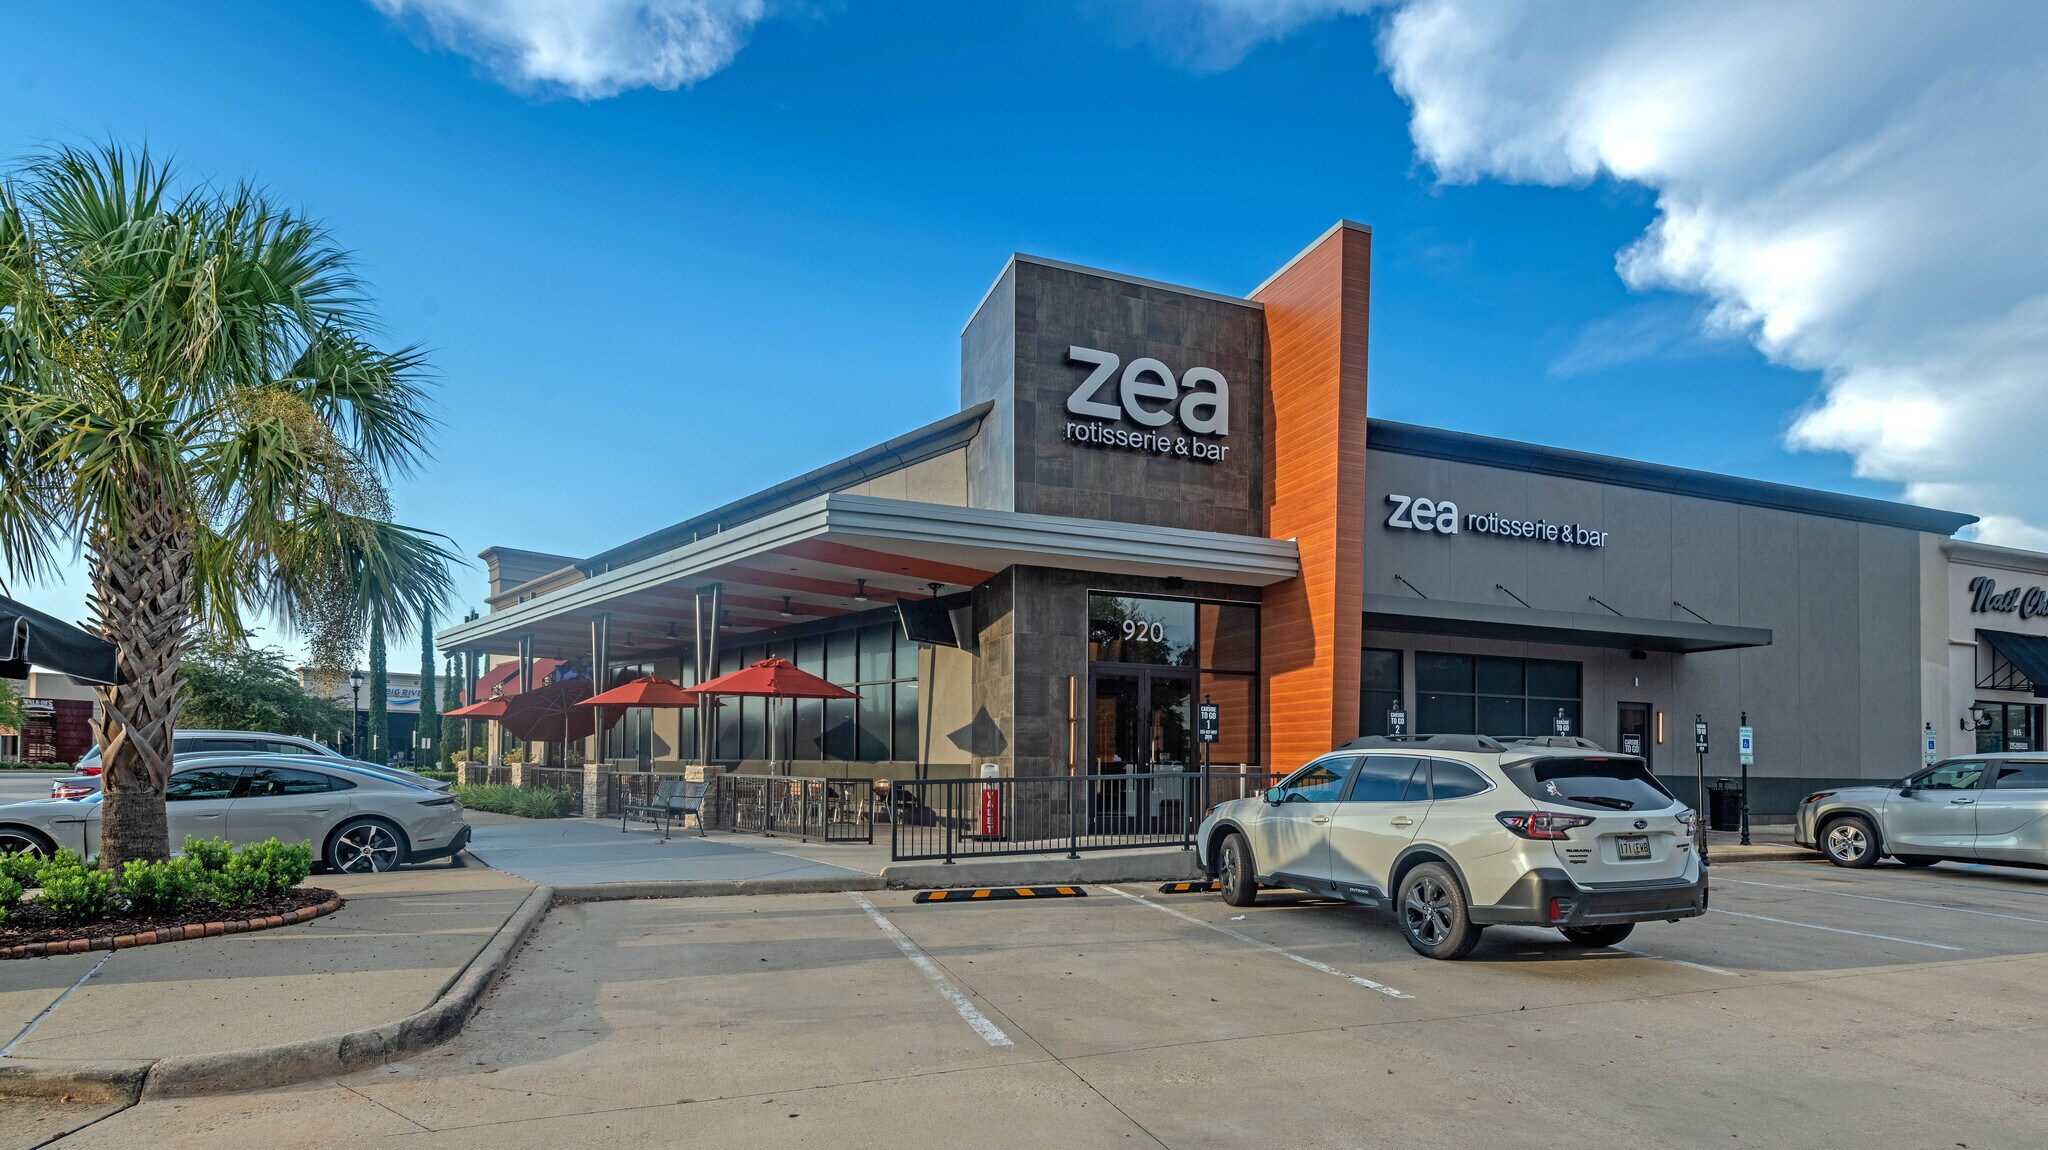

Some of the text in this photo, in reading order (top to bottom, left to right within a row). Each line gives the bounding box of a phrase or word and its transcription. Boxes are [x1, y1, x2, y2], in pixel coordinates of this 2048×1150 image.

[1066, 344, 1230, 436] zea
[1066, 421, 1230, 461] rotisserie & bar
[1387, 493, 1609, 547] zea rotisserie & bar
[1969, 576, 2021, 612] Nail
[1122, 619, 1164, 643] 920
[1201, 711, 1217, 720] TO GO
[1391, 717, 1405, 725] TO GO
[1206, 719, 1210, 730] 1
[1395, 724, 1400, 734] 2
[1562, 724, 1570, 732] GO
[1625, 744, 1639, 753] TO GO
[986, 791, 994, 833] VALET
